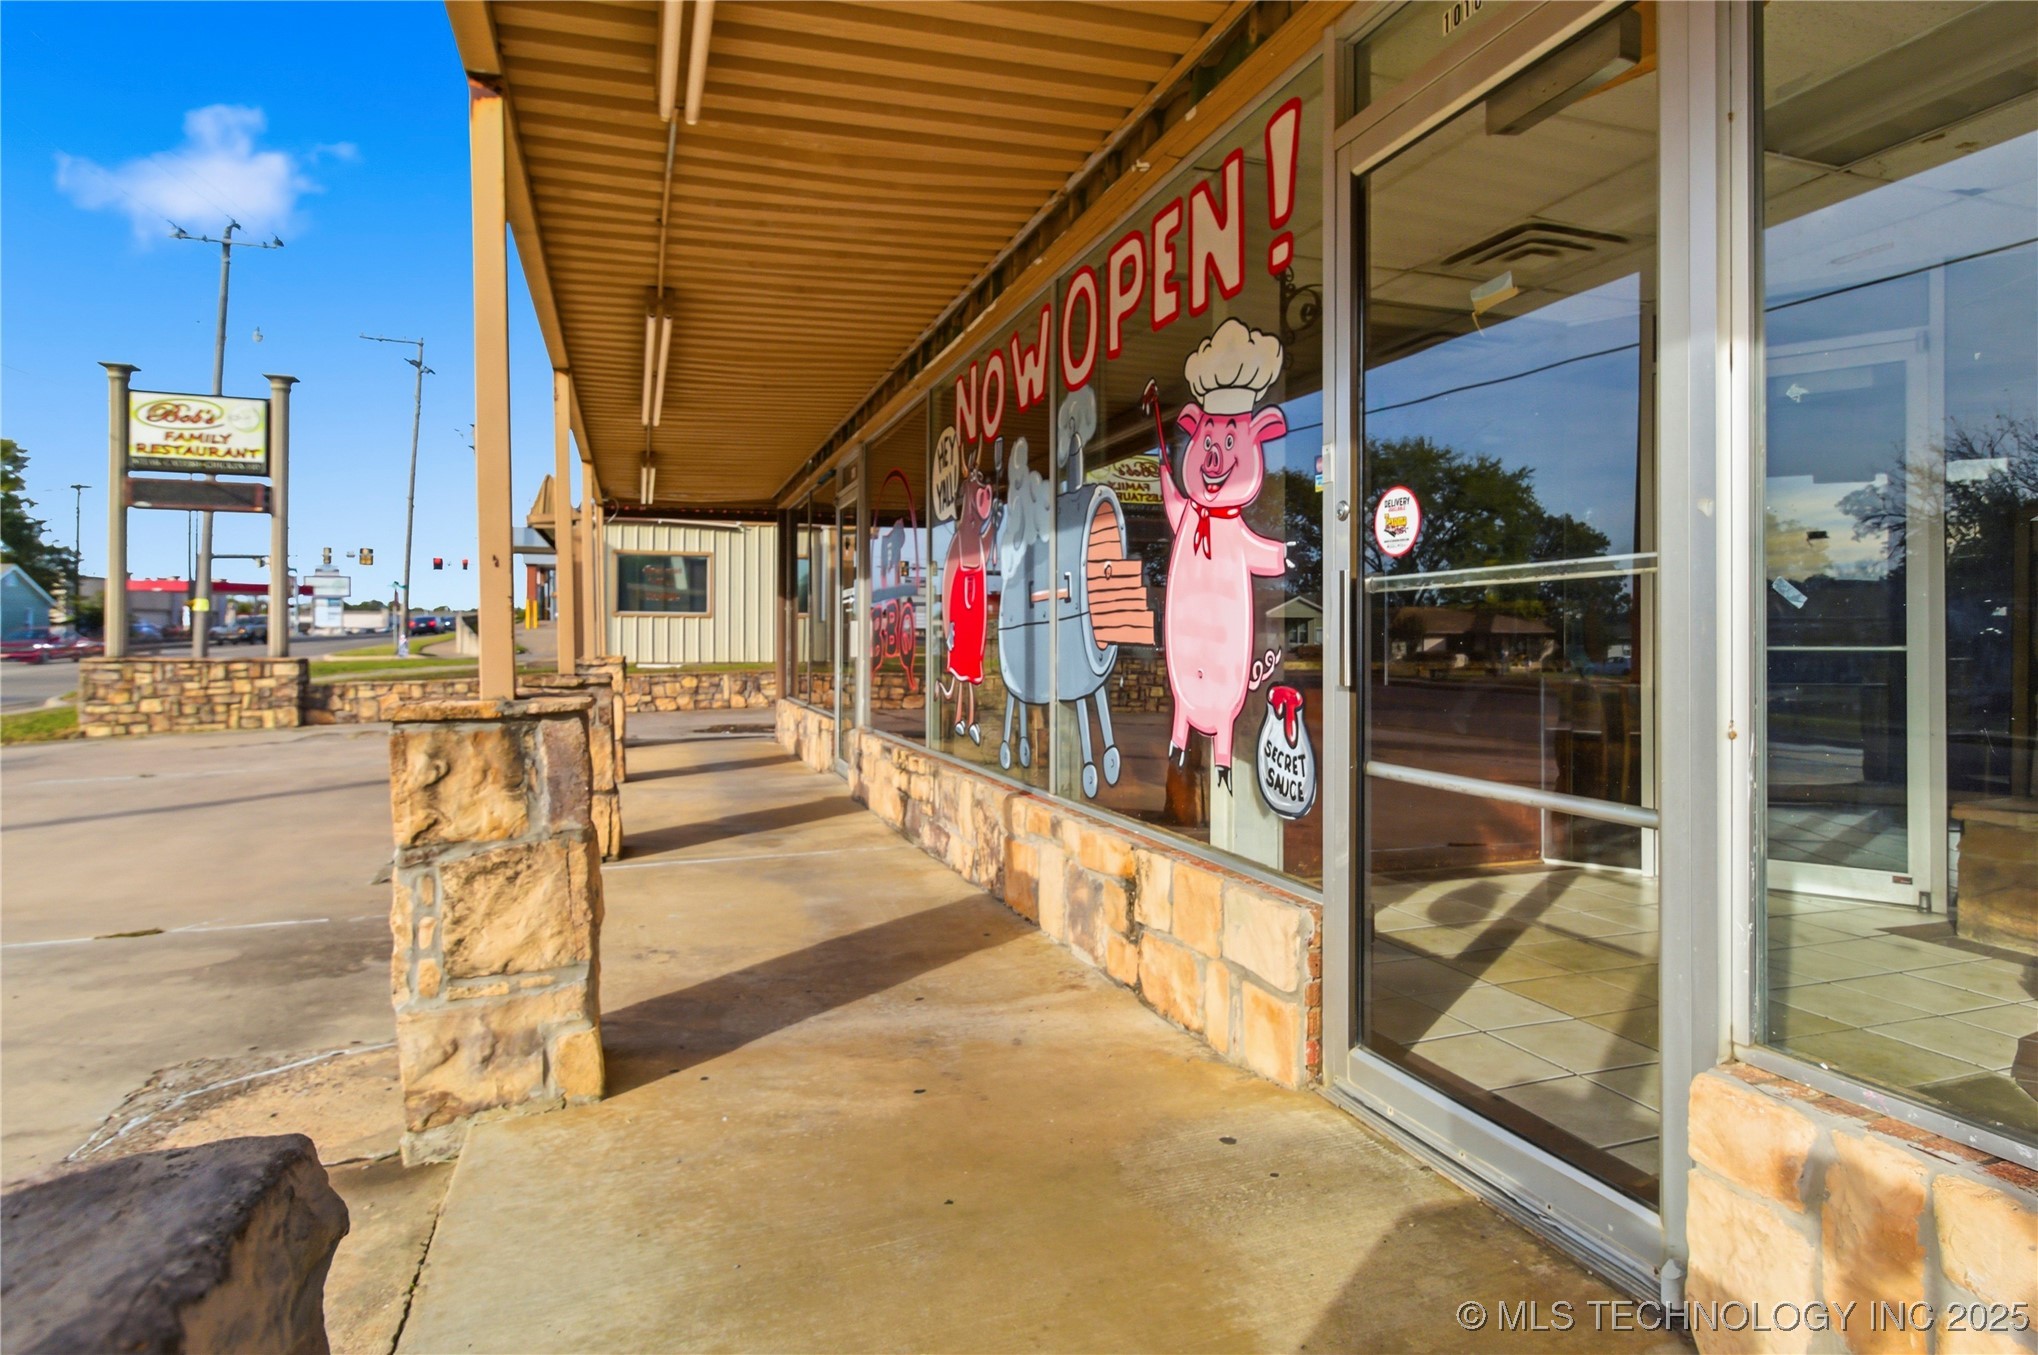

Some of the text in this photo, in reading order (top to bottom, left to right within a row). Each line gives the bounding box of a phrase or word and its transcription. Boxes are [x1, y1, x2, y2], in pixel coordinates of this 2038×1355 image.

[956, 97, 1302, 443] NOW OPEN!
[146, 402, 216, 424] Bob's
[136, 443, 260, 458] RESTAURANT
[165, 430, 232, 444] FAMILY
[937, 433, 957, 473] HEY
[1384, 496, 1410, 508] DELIVERY
[1264, 740, 1306, 778] SECRET
[1266, 767, 1304, 802] SAUCE
